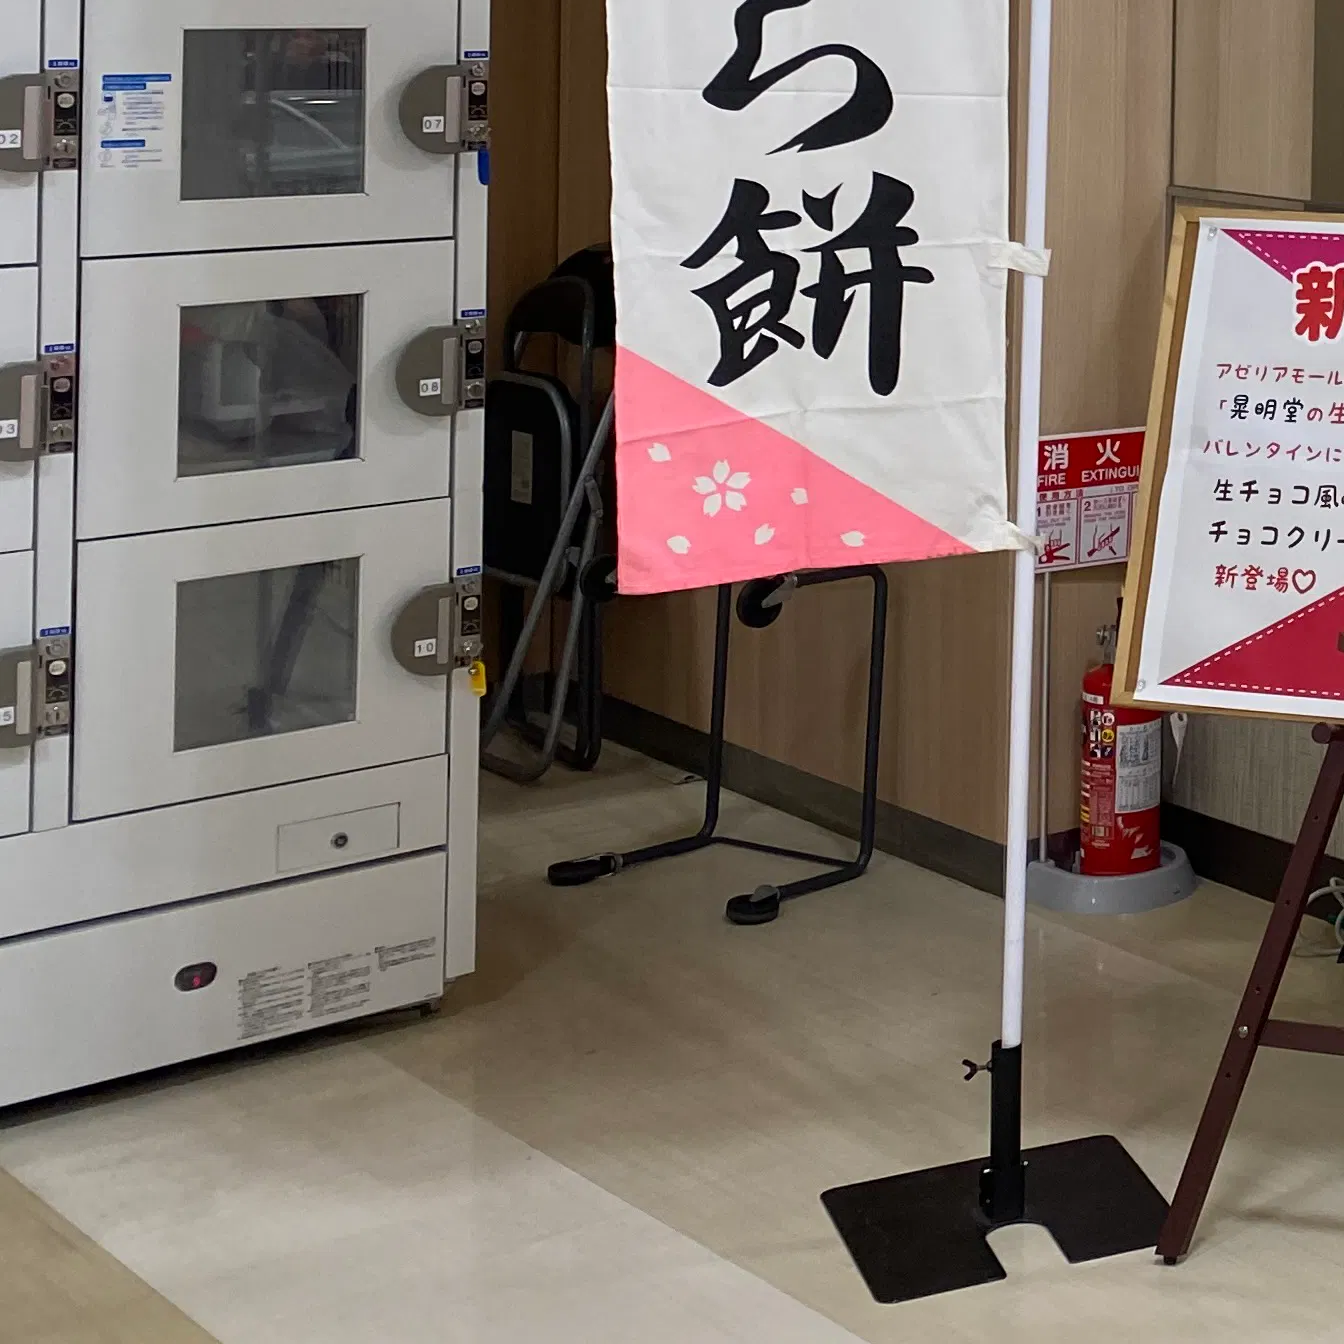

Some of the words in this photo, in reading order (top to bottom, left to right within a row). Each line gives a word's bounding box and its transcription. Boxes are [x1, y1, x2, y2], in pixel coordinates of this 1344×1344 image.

[423, 118, 443, 130] 07
[421, 383, 439, 393] 08
[1037, 472, 1067, 488] FIRE
[1083, 501, 1092, 512] 2
[416, 642, 435, 654] 10
